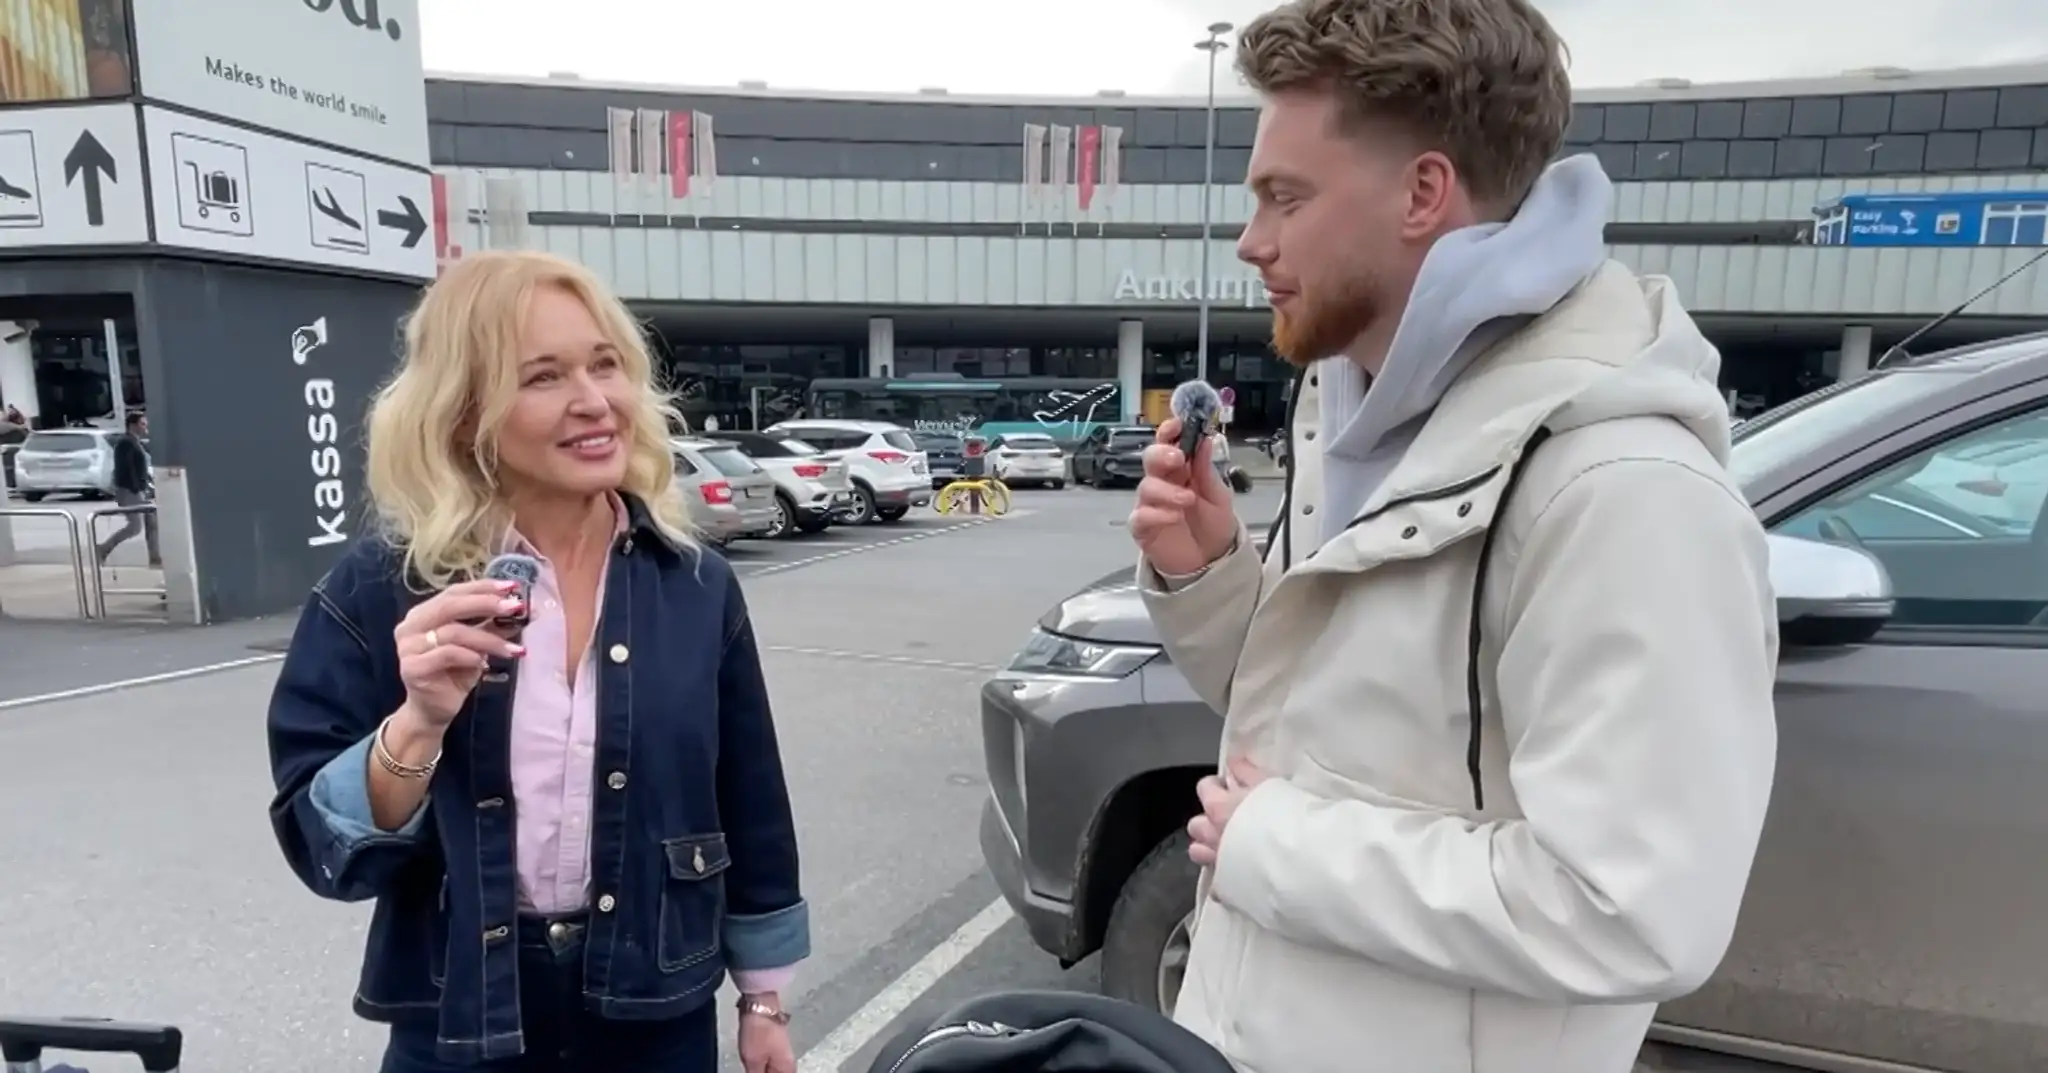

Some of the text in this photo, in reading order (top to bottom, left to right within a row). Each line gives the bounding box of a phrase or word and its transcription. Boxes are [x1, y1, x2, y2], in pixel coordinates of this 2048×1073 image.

[205, 56, 388, 125] Makes the world smile
[304, 378, 348, 547] kassa
